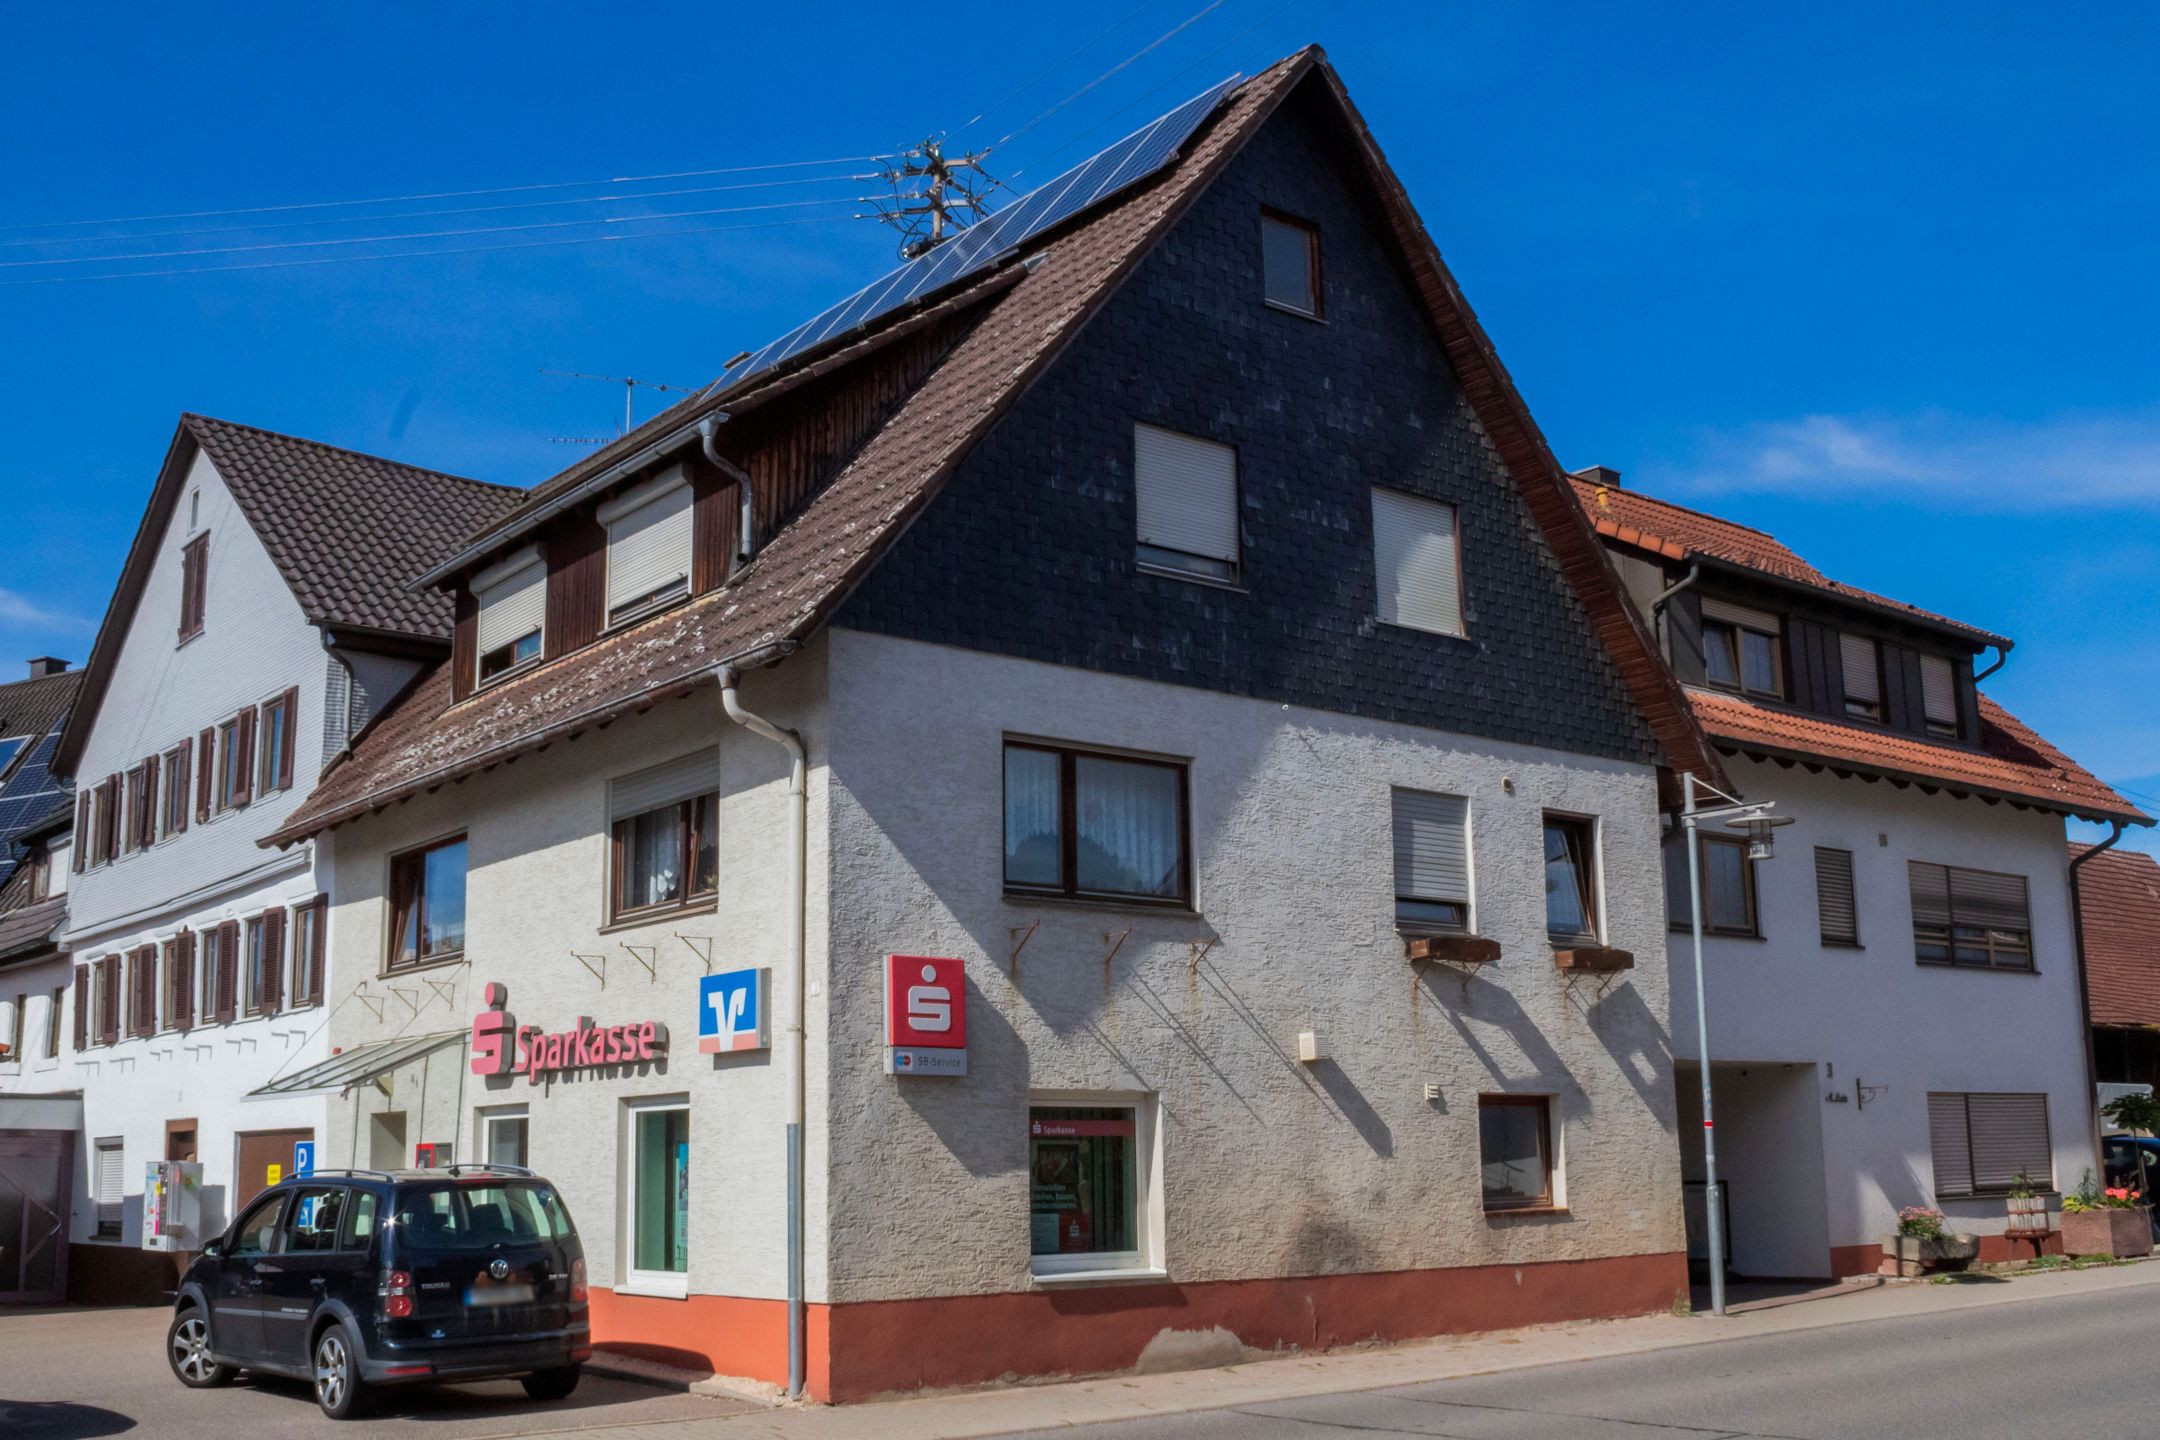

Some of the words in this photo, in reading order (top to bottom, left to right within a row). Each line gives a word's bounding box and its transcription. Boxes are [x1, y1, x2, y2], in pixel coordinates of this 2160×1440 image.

[514, 1015, 660, 1084] Sparkasse
[917, 1056, 961, 1067] SB-Service
[1043, 1125, 1076, 1135] Sparkasse
[297, 1147, 308, 1179] P
